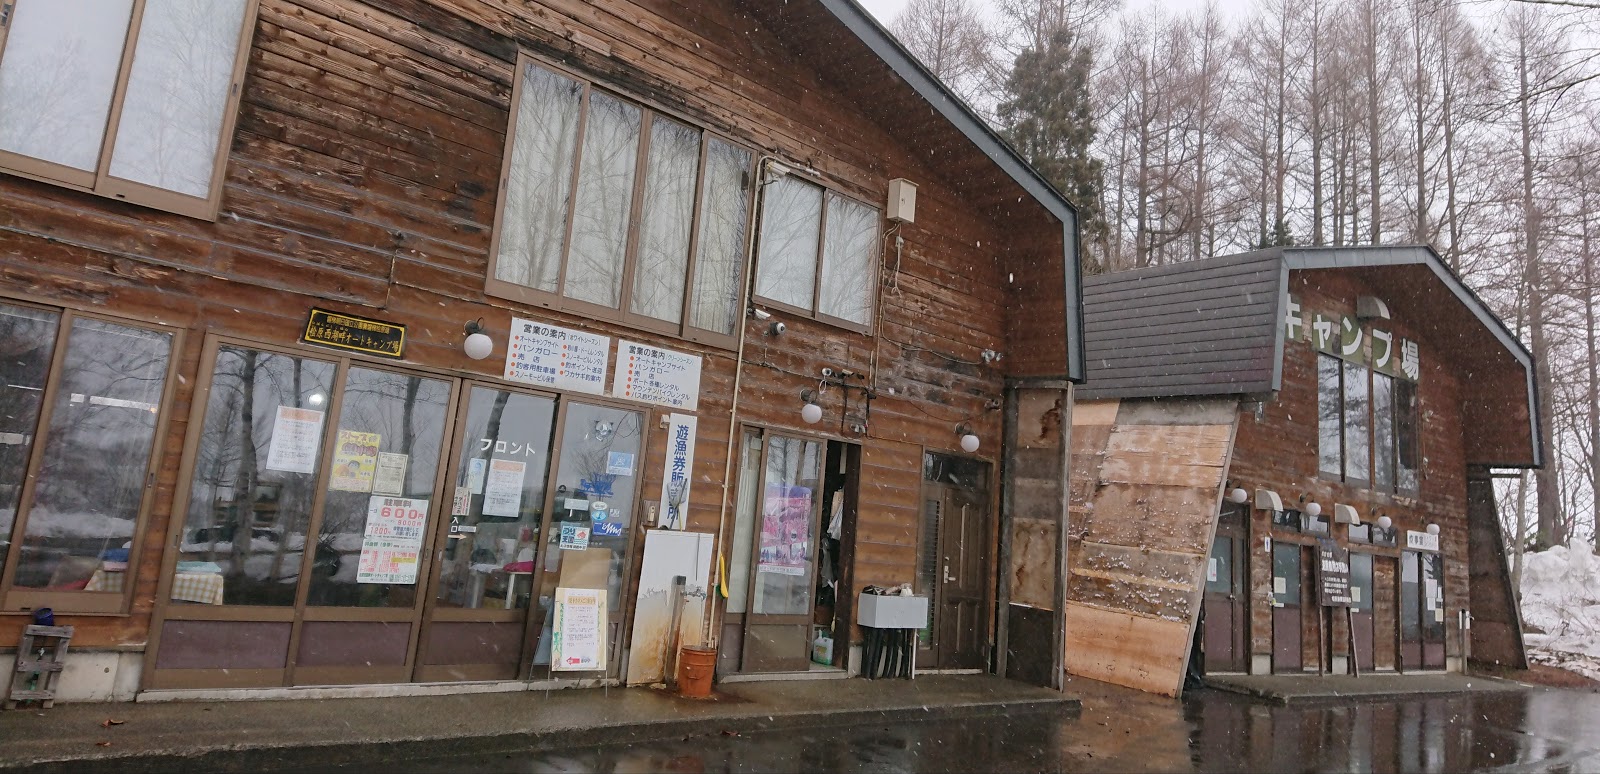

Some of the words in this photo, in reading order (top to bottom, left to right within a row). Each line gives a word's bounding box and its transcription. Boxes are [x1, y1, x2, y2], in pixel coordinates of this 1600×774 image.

[524, 324, 566, 340] 営業の案内
[520, 336, 559, 348] オートキャンプサイト
[518, 344, 558, 356] バンガロー
[629, 345, 666, 360] 営業の案内
[516, 362, 556, 374] 釣客用駐車場
[634, 364, 670, 374] バンガロー
[636, 356, 686, 372] オートキャンプサイト
[564, 370, 602, 382] ワカサギ釣案内
[480, 438, 535, 456] フロント
[450, 516, 459, 532] 入口
